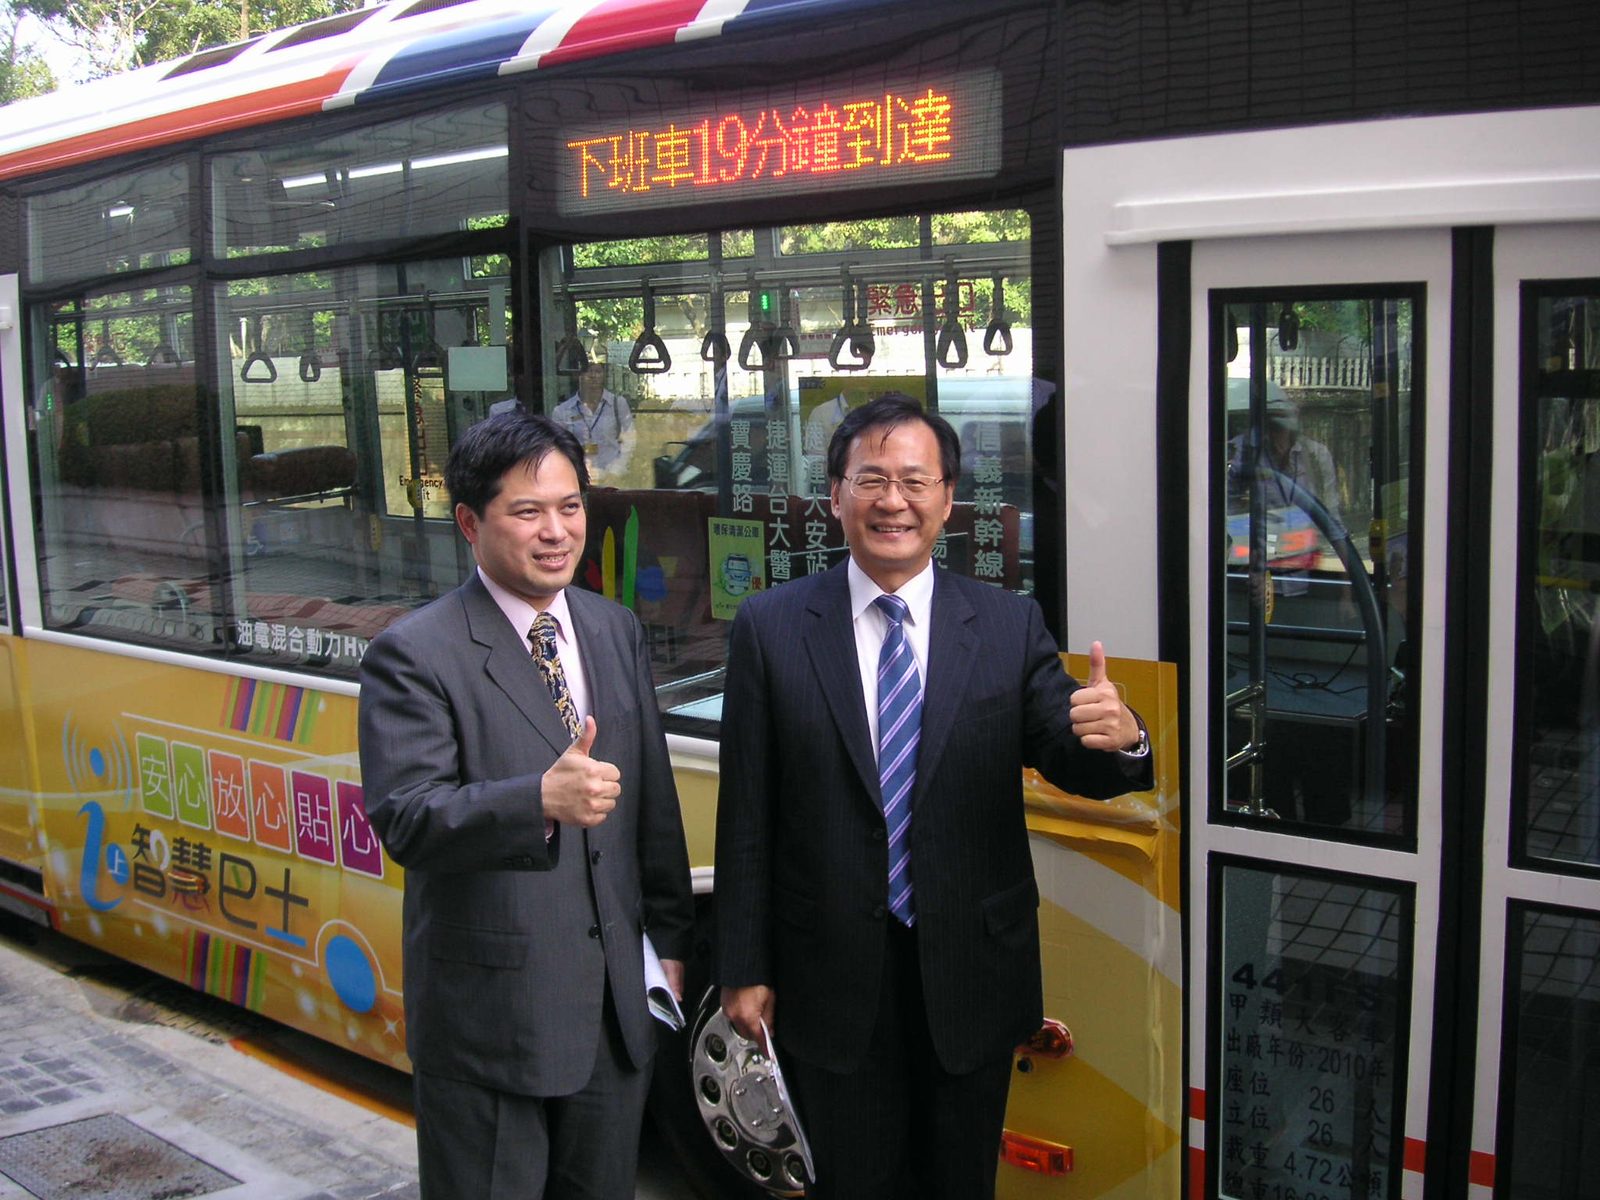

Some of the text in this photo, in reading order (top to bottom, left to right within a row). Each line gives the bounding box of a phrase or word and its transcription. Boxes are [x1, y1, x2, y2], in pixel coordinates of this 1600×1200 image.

[567, 89, 952, 198] 下班車19分鐘到達
[730, 419, 754, 514] 寶慶路
[141, 754, 381, 856] 安心放心貼心
[131, 822, 309, 948] 智慧巴士
[1225, 1065, 1271, 1097] 座位
[1308, 1085, 1335, 1114] 26
[1226, 1100, 1271, 1131] 立位
[1307, 1119, 1334, 1148] 26
